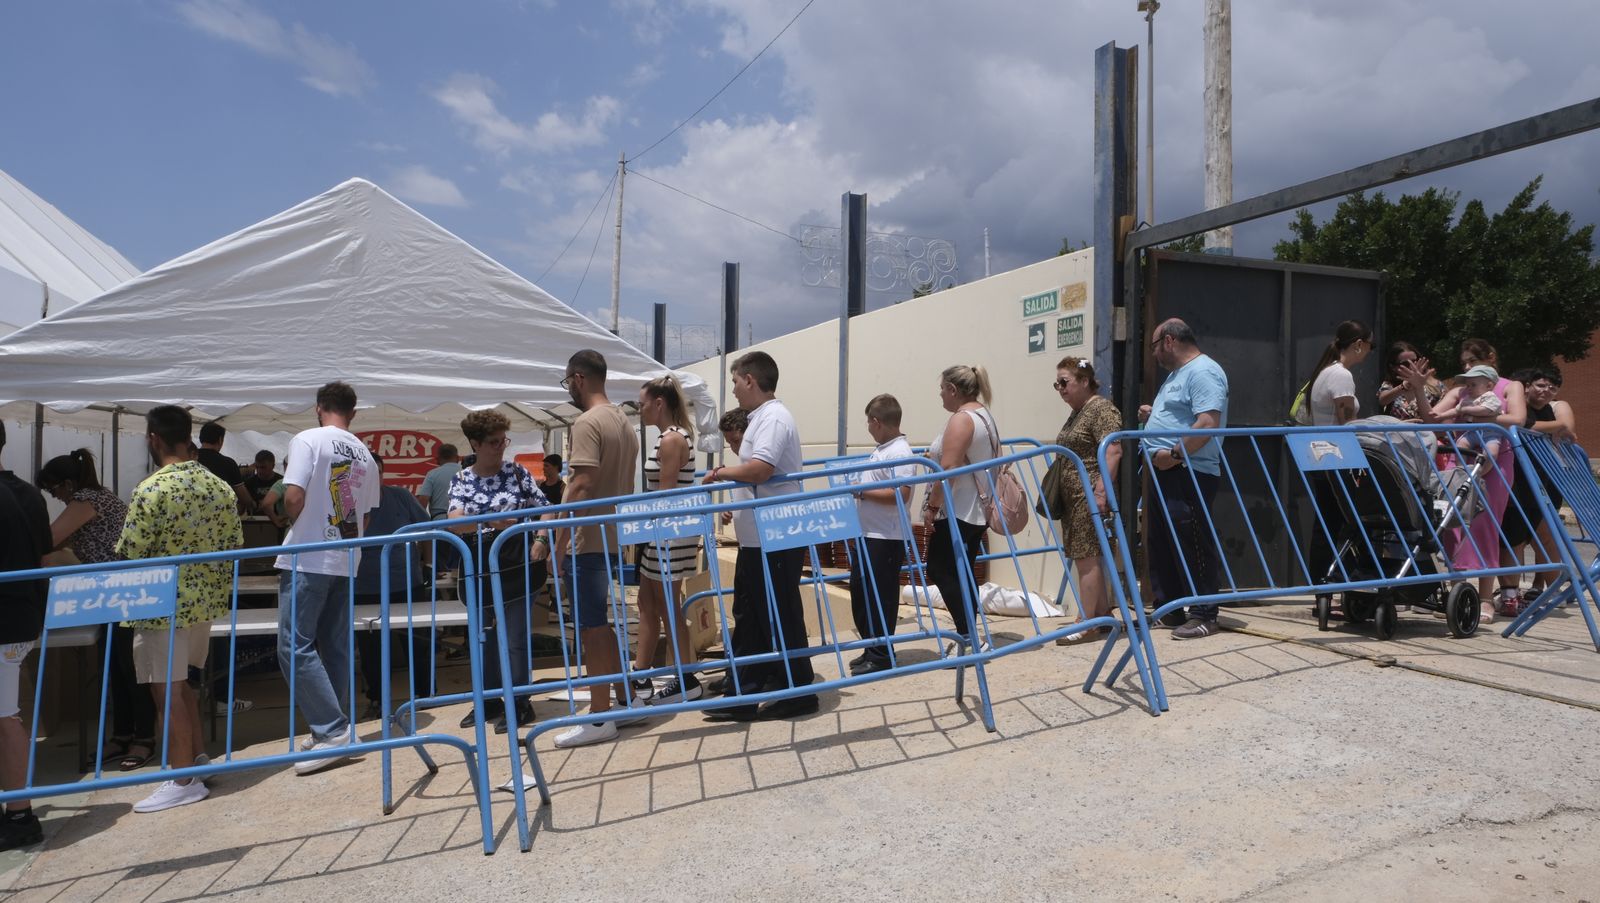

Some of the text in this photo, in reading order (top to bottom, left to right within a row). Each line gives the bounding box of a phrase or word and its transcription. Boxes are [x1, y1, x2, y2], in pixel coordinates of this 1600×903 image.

[1025, 295, 1055, 315] SALIDA
[1058, 316, 1082, 332] SALIDA
[332, 440, 368, 462] NEW!
[760, 497, 850, 522] AYUNTAMIENTO
[623, 522, 640, 535] DE
[765, 528, 785, 541] DE
[55, 568, 173, 594] AYUNAMIENTO
[54, 600, 78, 616] DE
